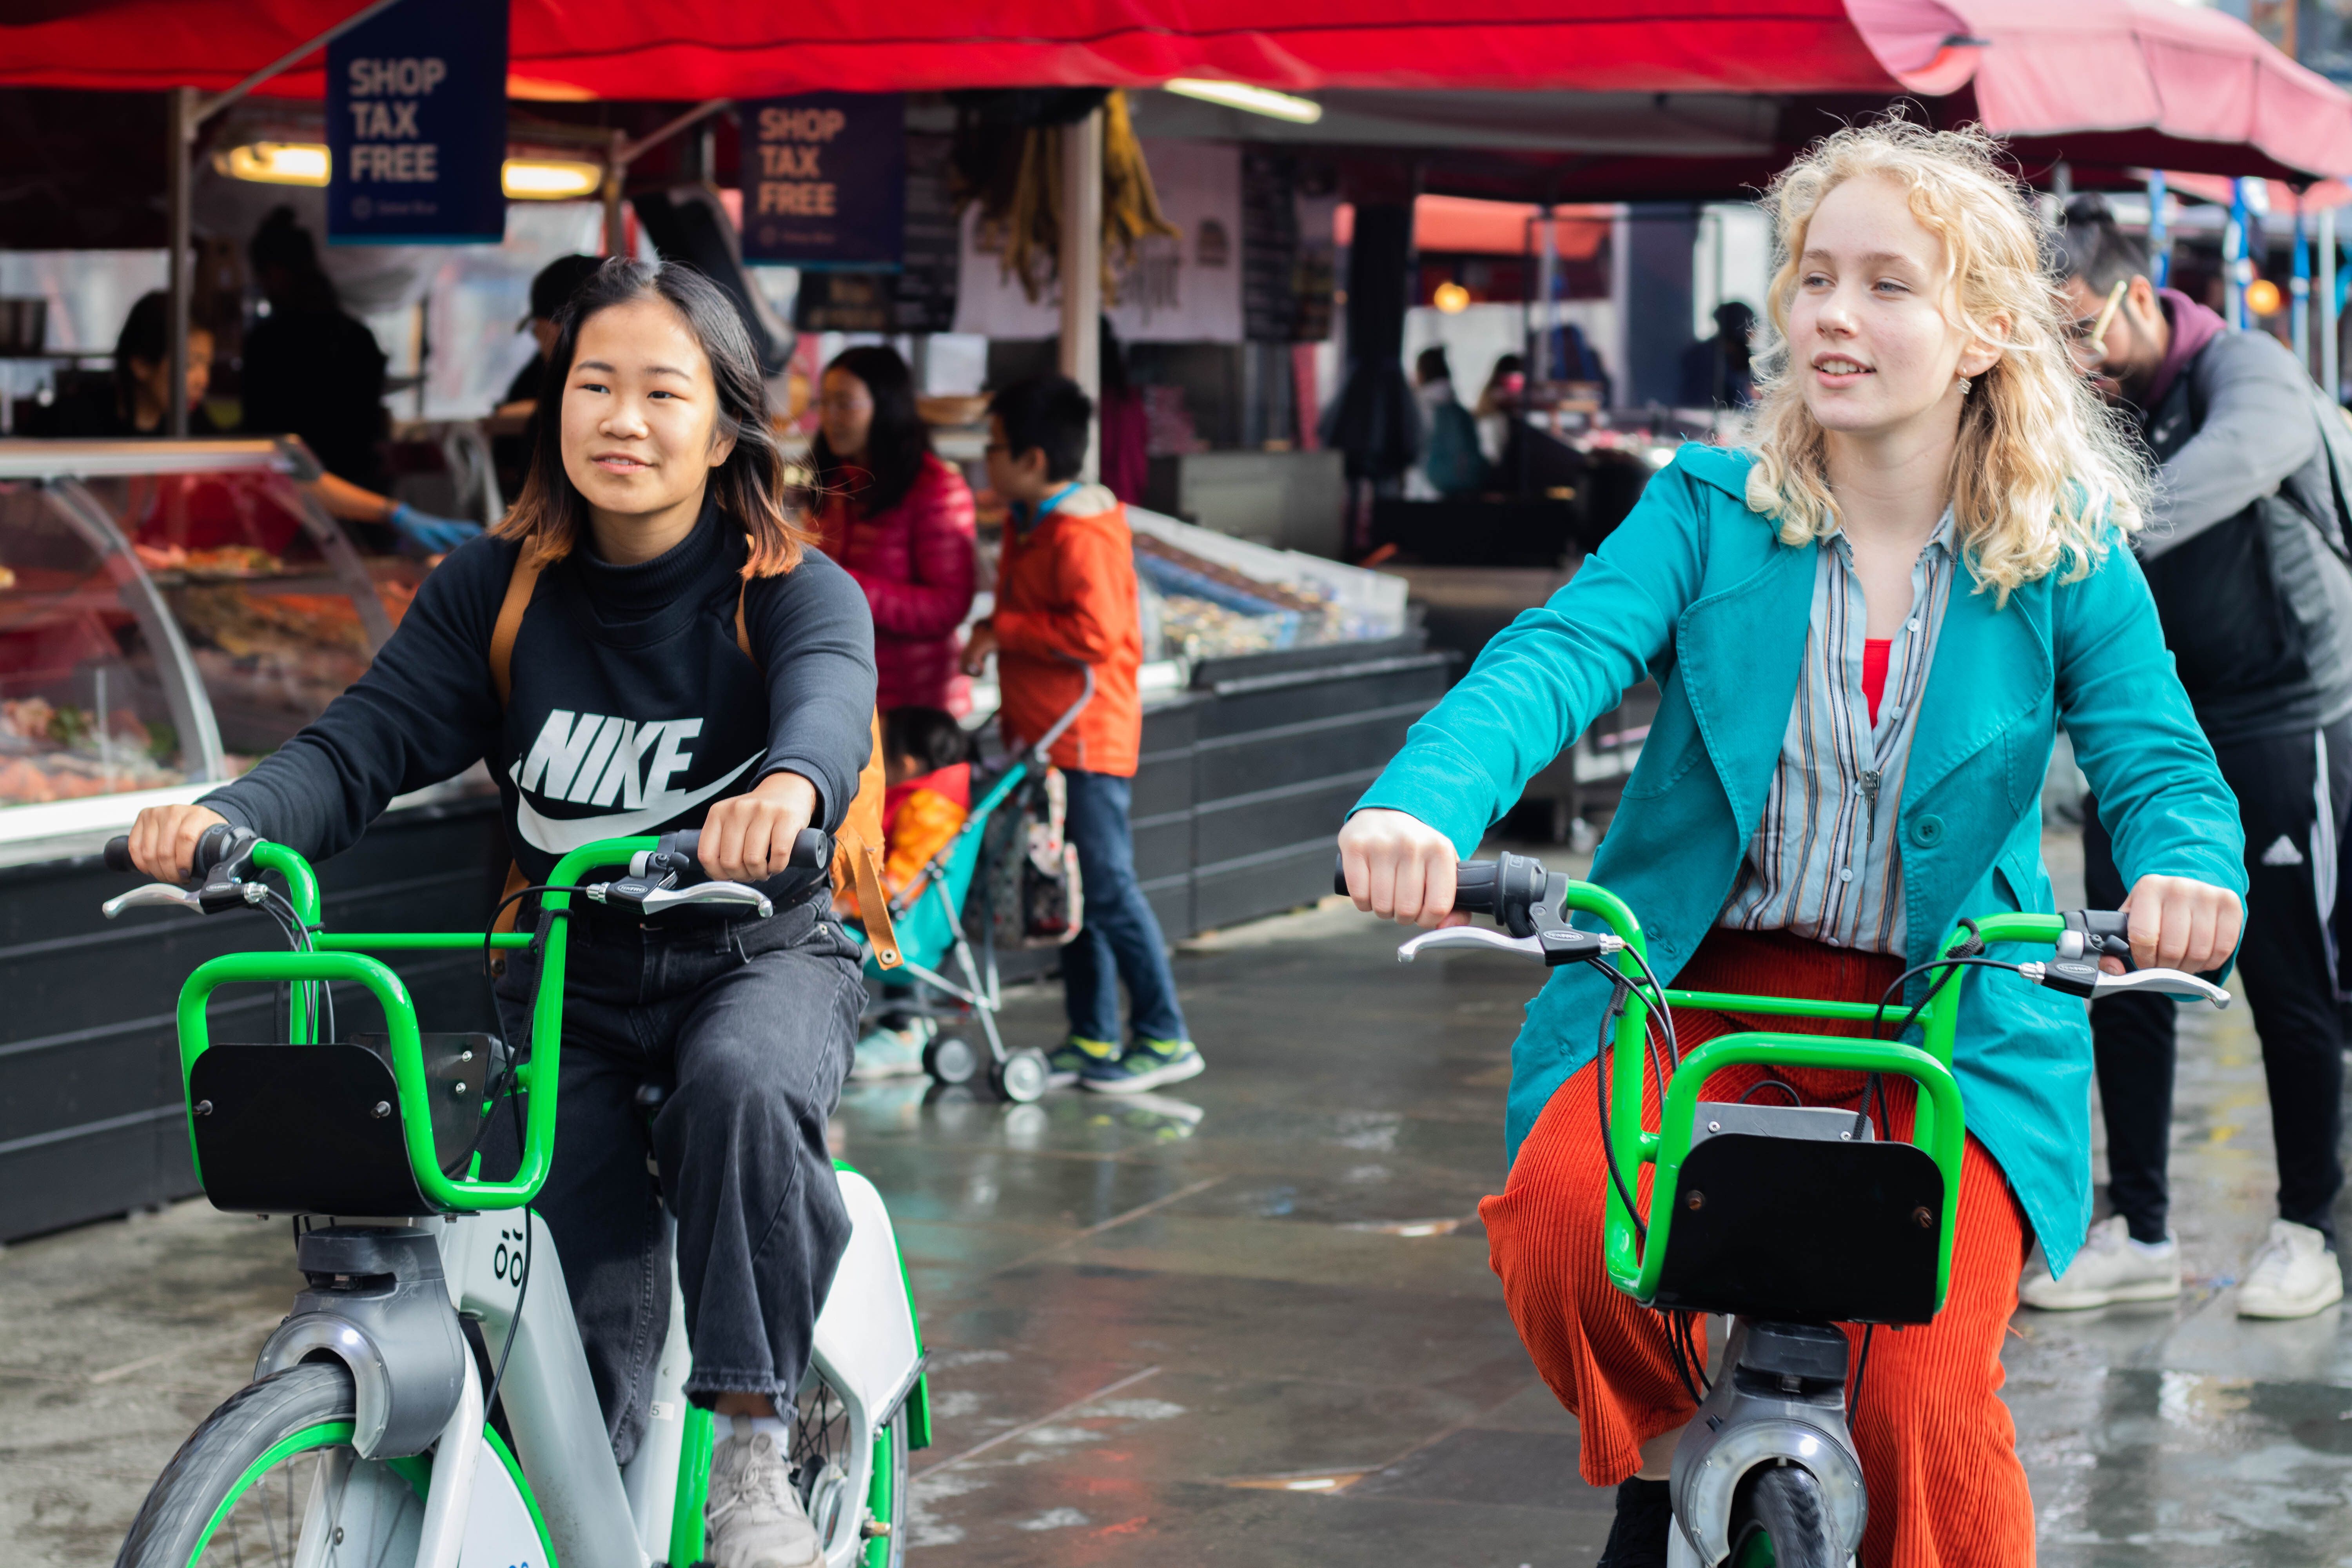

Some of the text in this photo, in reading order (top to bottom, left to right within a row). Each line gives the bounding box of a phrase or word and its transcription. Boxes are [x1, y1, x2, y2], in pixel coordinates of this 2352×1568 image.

[349, 58, 446, 96] SHOP
[349, 101, 419, 139] TAX
[758, 108, 846, 142] SHOP
[350, 143, 439, 182] FREE
[758, 144, 821, 178] TAX
[758, 182, 837, 215] FREE
[521, 709, 703, 809] NIKE
